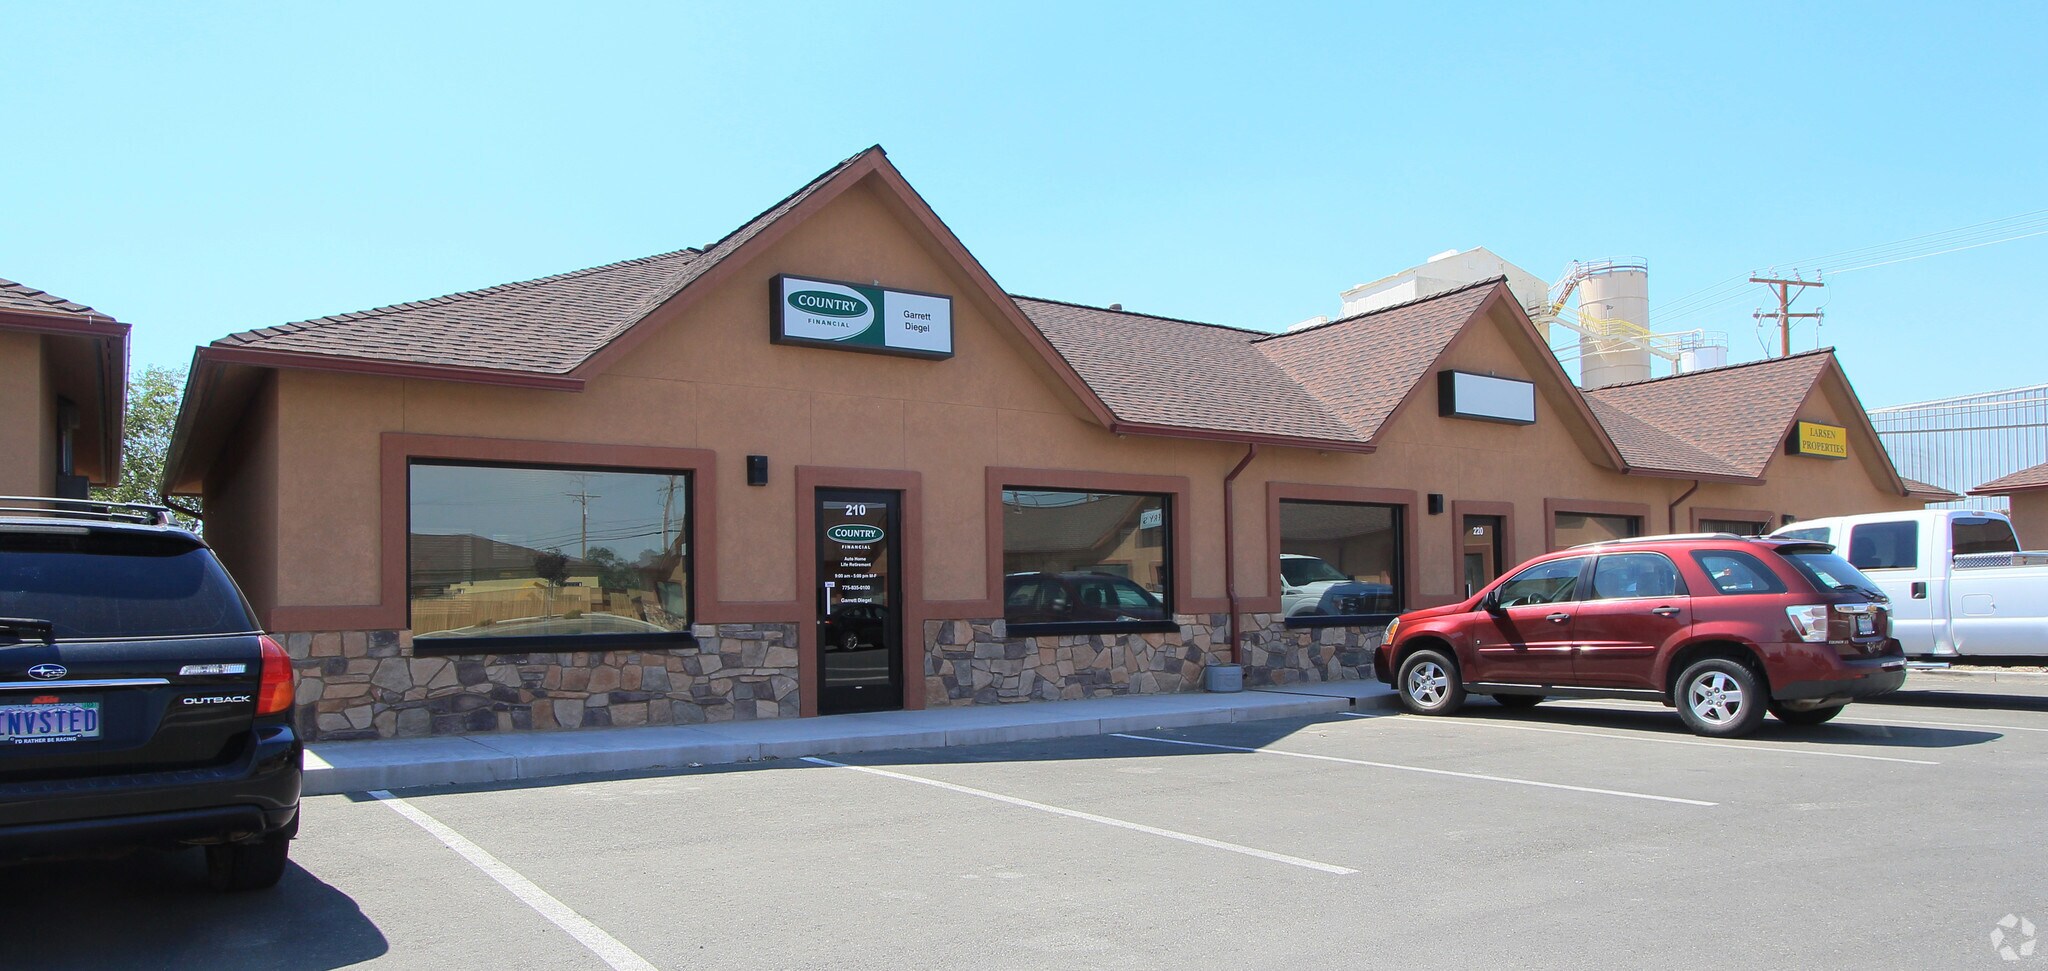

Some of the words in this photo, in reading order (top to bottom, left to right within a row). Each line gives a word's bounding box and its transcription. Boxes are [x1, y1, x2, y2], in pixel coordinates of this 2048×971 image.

[798, 294, 858, 312] COUNTRY
[903, 310, 931, 321] Garrett
[807, 318, 850, 328] FINANCIAL
[905, 322, 930, 333] Diegel
[1810, 427, 1836, 439] LARSEN
[1802, 440, 1844, 453] PROPERTIES
[845, 504, 866, 516] 210
[835, 528, 876, 538] COUNTRY
[1472, 526, 1484, 536] 220
[183, 695, 251, 705] OUTBACK
